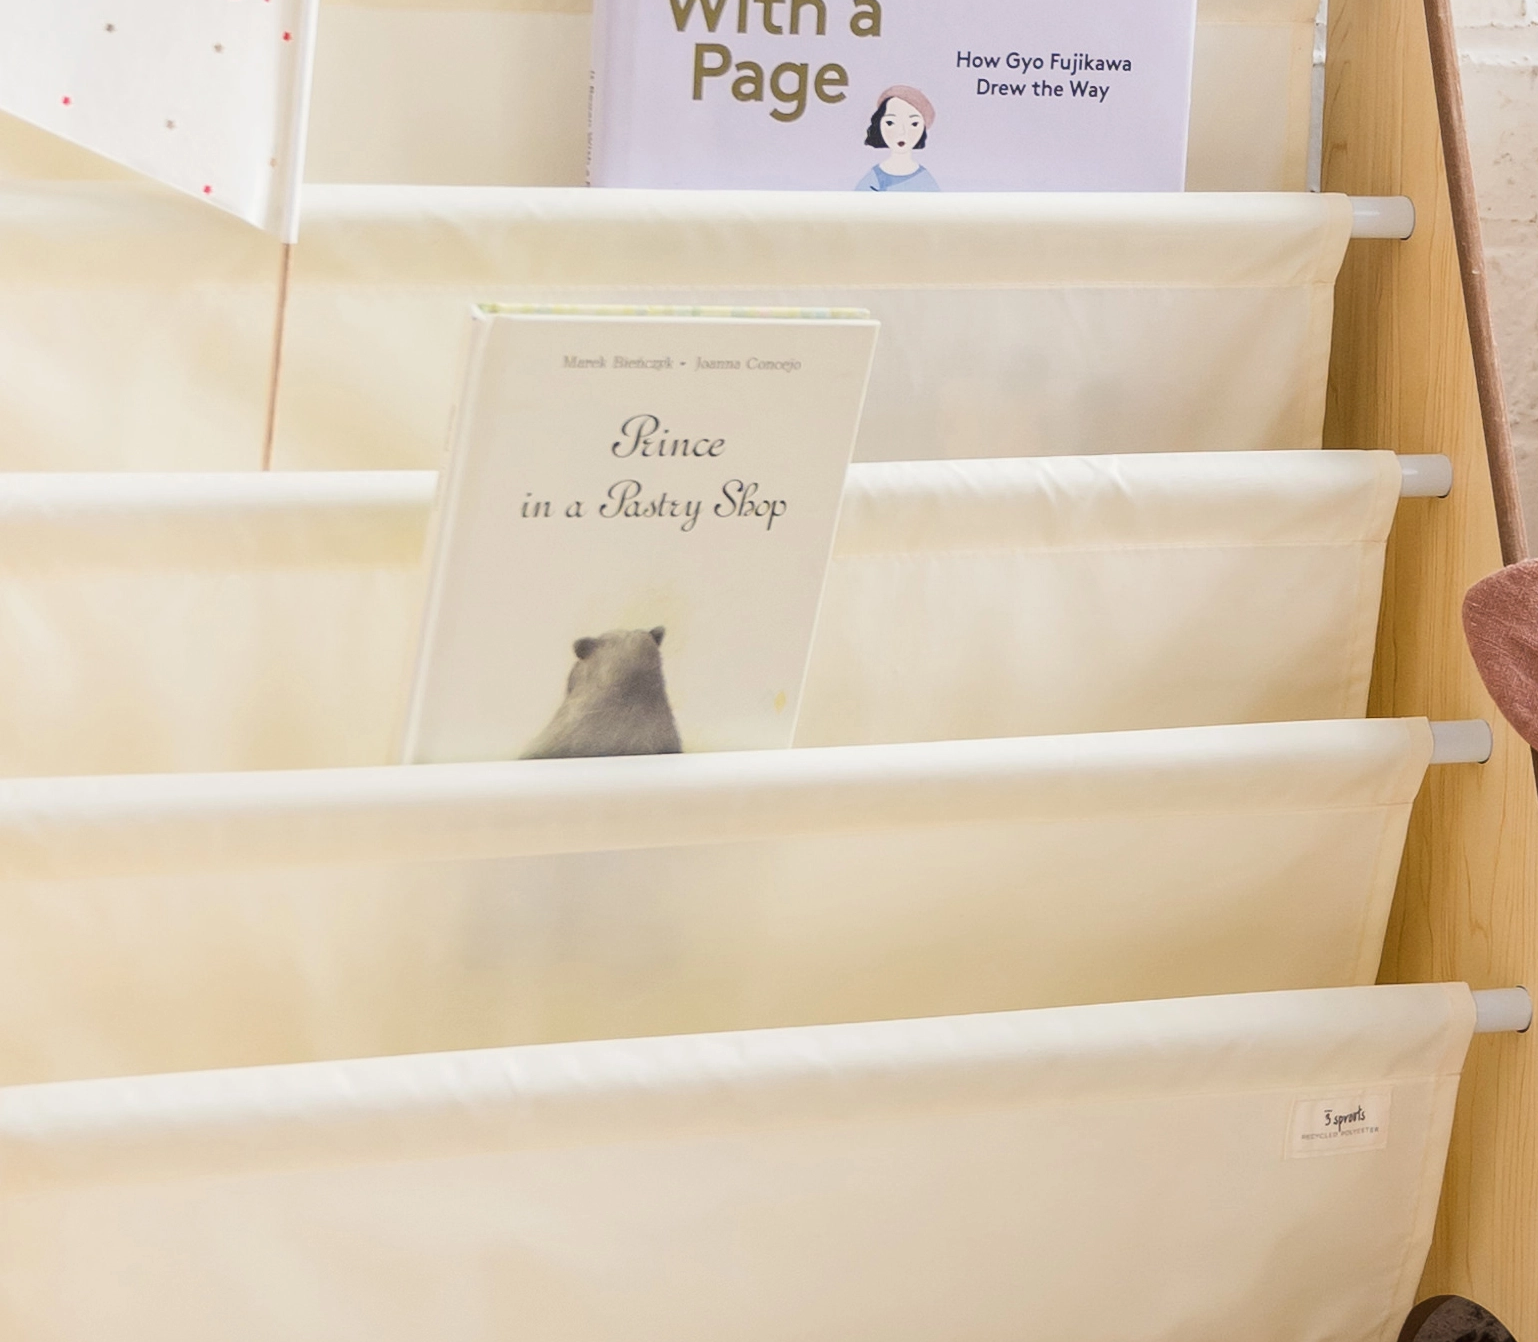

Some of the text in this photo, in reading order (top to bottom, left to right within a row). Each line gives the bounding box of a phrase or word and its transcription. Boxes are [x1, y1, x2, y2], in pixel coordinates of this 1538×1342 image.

[956, 51, 1132, 76] How Gyo Fujikawa
[691, 43, 850, 122] Page
[976, 78, 1110, 103] Drew the Way
[563, 356, 606, 370] Marek
[694, 357, 741, 372] Joanna
[746, 358, 802, 374] Concejo
[611, 414, 726, 458] Prince
[520, 479, 788, 532] in a Pastry Shop
